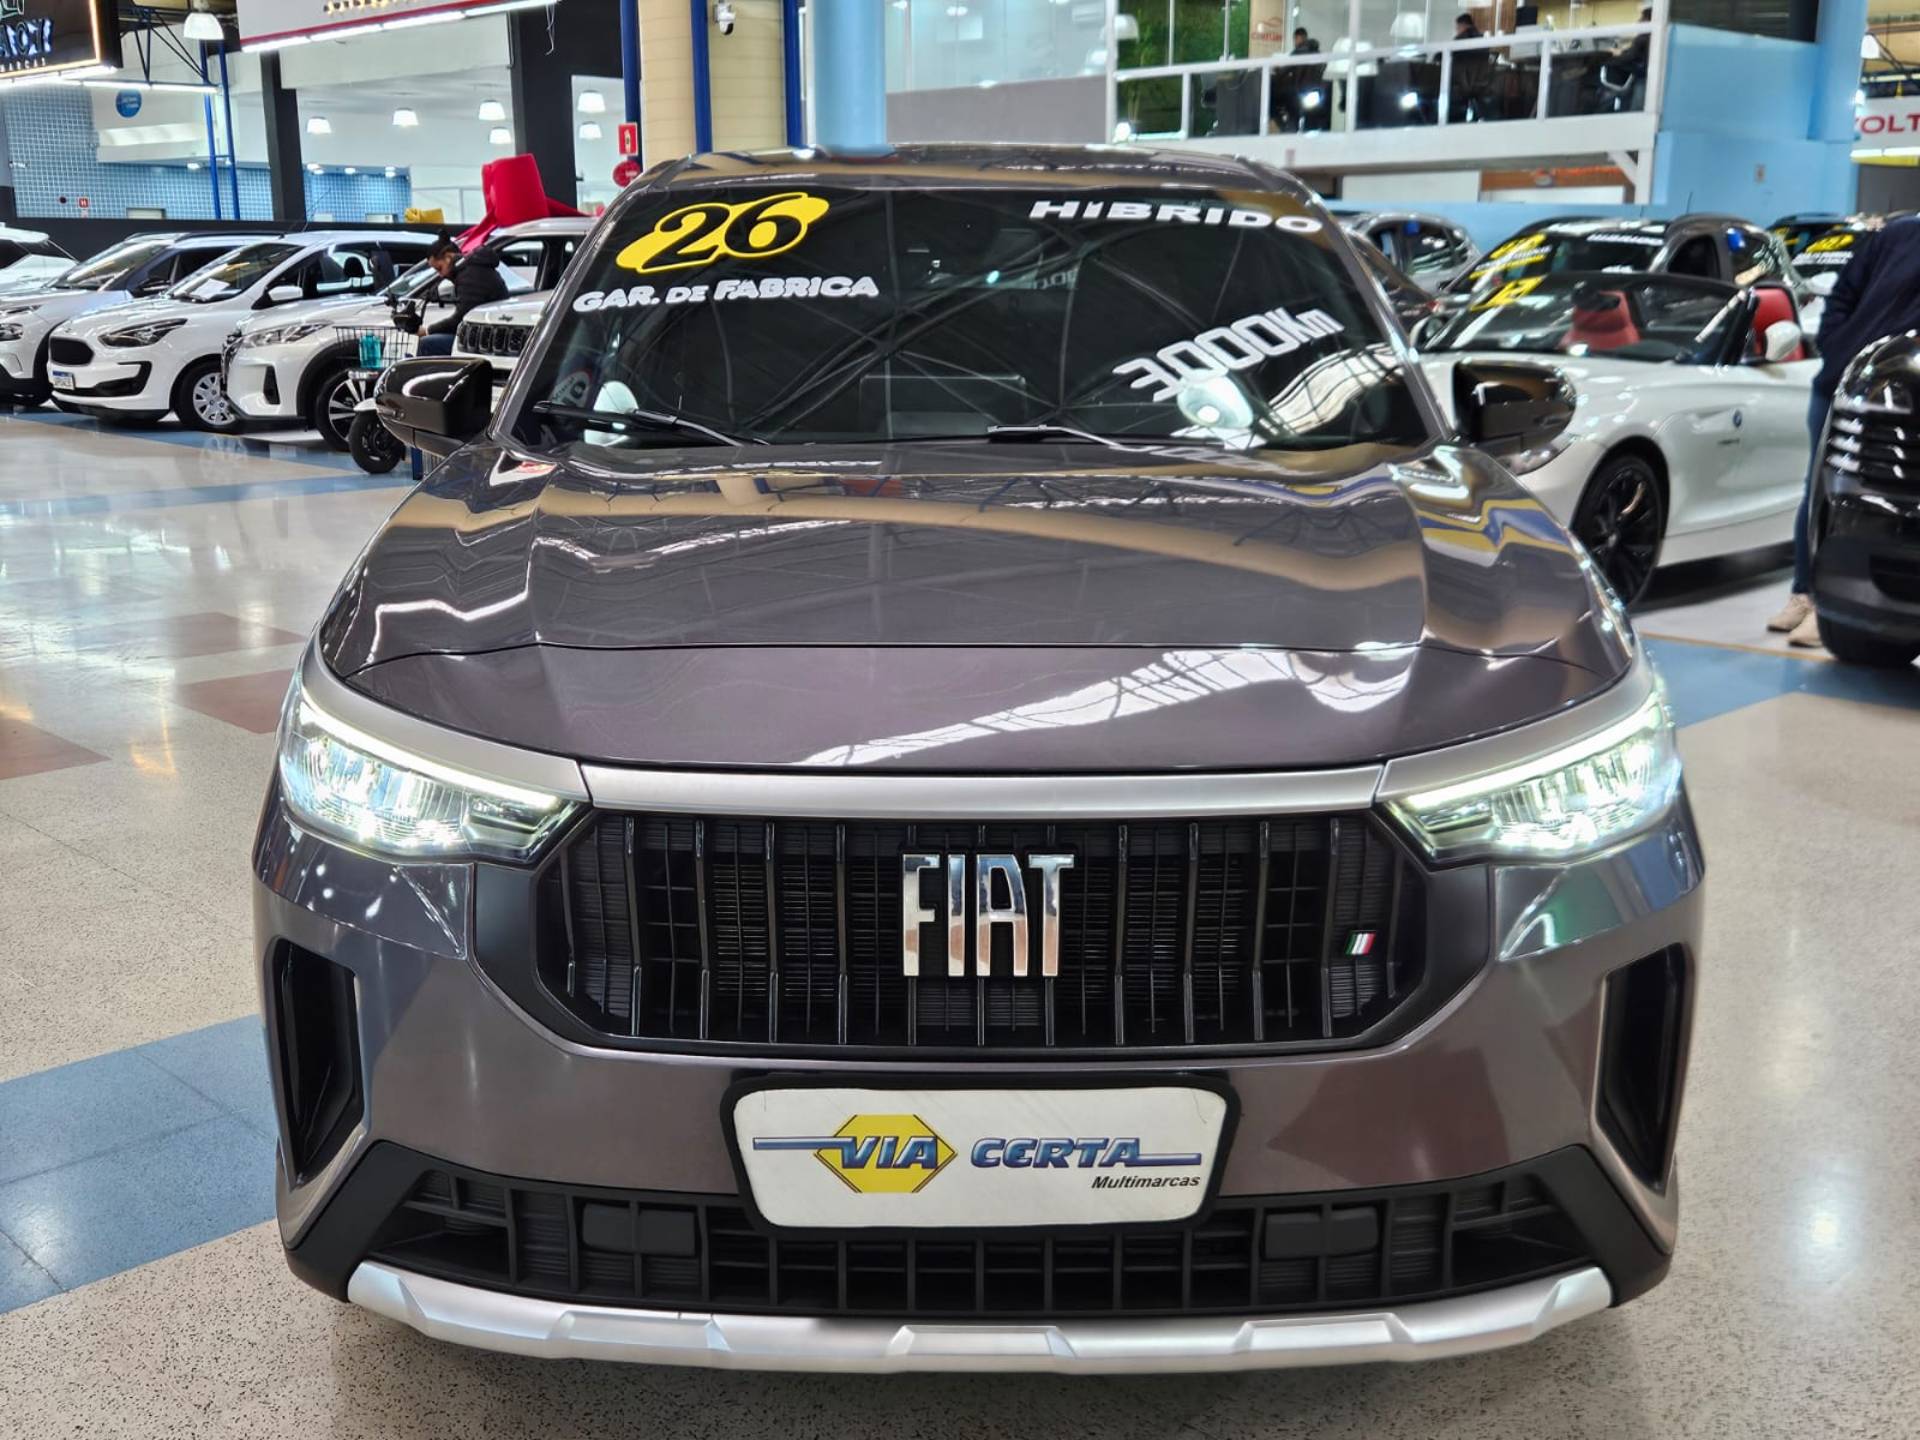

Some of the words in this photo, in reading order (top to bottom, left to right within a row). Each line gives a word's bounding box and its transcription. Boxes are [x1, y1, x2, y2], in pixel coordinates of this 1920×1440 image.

[1856, 113, 1920, 134] OLT
[637, 192, 811, 273] 26
[572, 285, 660, 312] GAR.
[665, 285, 710, 304] DE
[903, 854, 1074, 977] FIAT
[842, 1136, 938, 1169] VIA
[971, 1138, 1141, 1168] CERTA
[1091, 1175, 1201, 1189] Multimarcas
